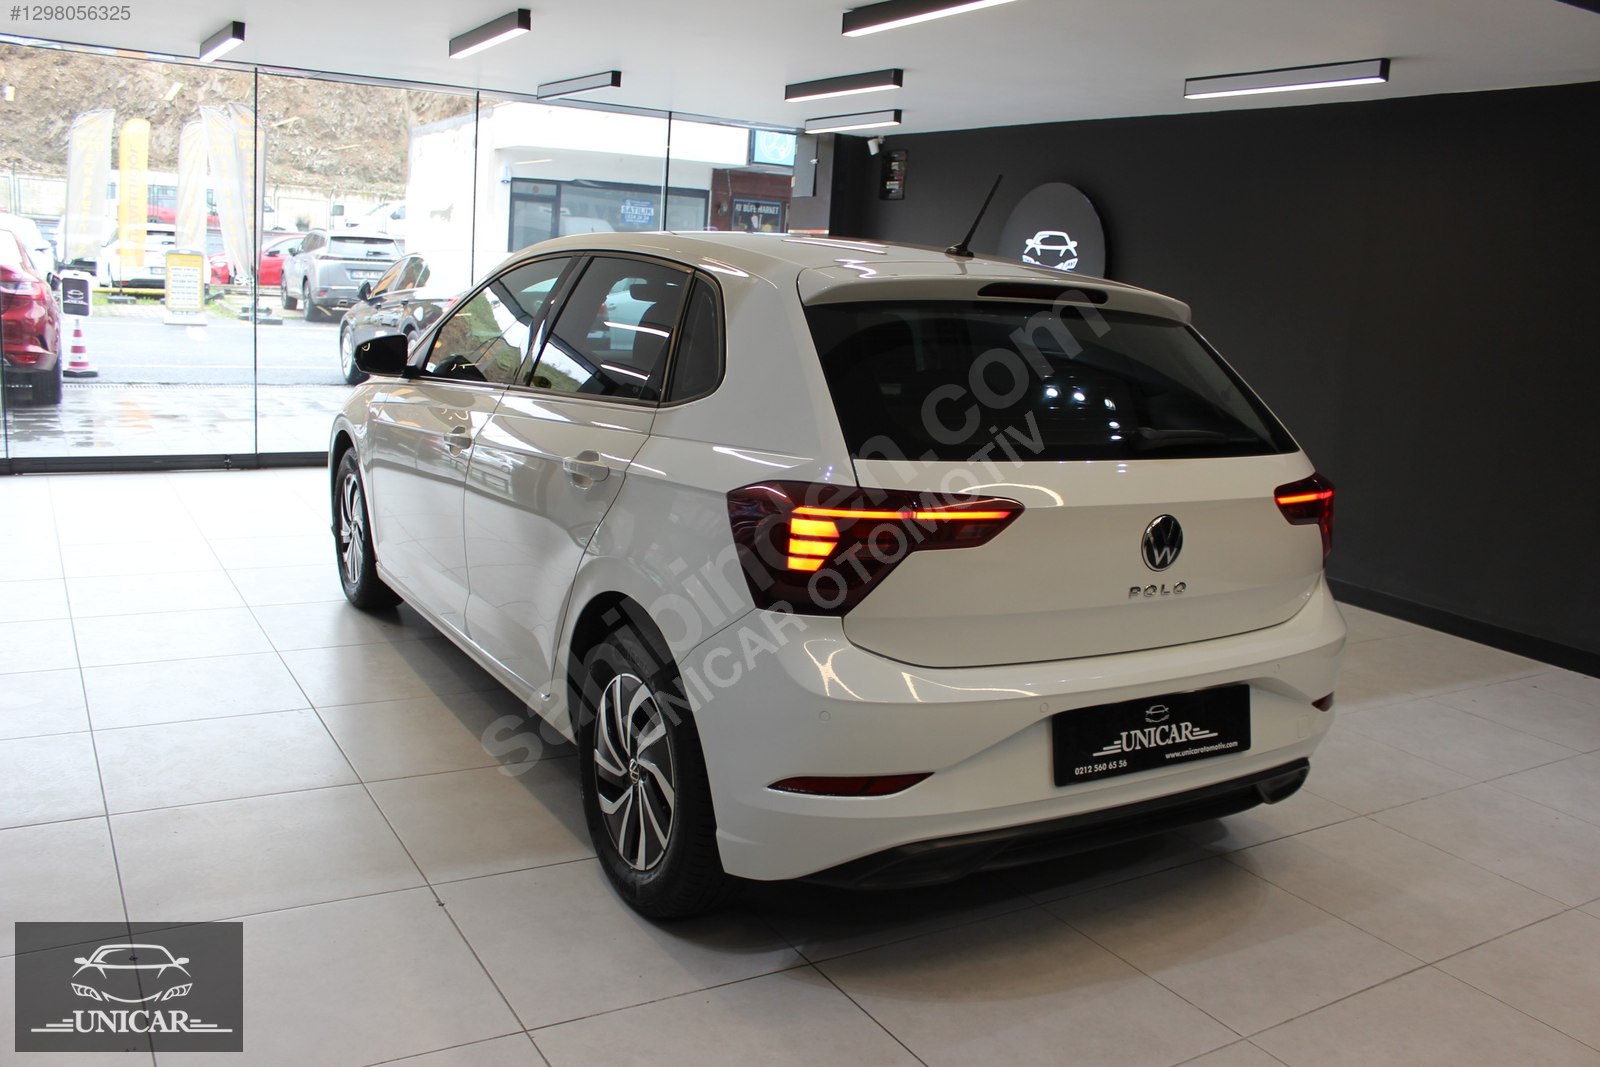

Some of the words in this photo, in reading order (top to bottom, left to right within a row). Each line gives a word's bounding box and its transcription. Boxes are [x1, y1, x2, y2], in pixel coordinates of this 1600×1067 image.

[1128, 581, 1187, 600] POLO
[1120, 721, 1194, 752] UNICAR
[1165, 740, 1239, 760] www.unicarotomotiv.com
[1074, 765, 1092, 775] 0212
[1094, 763, 1107, 772] 560
[1108, 762, 1117, 770] 65
[1118, 760, 1127, 768] 56
